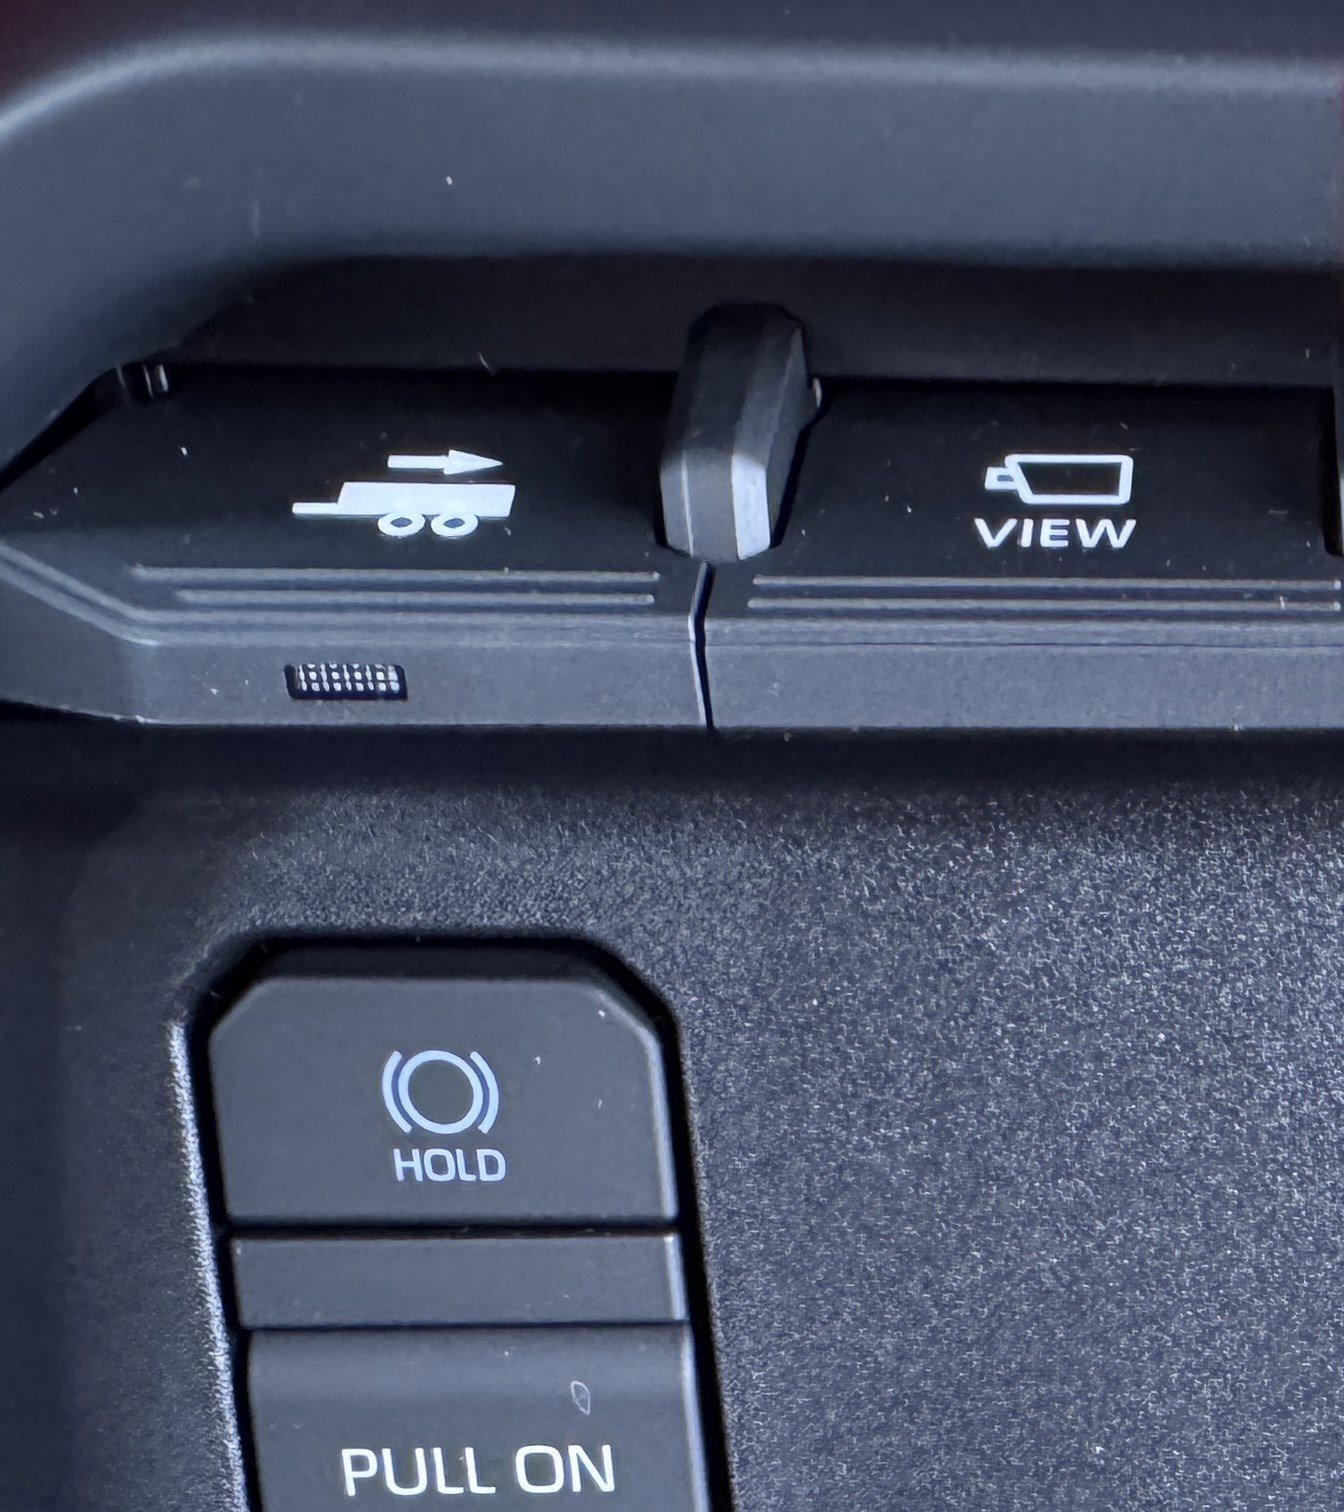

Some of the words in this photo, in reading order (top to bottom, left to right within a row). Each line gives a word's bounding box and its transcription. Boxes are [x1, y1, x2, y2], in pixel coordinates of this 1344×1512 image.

[973, 518, 1137, 550] VIEW
[393, 1148, 506, 1183] HOLD
[341, 1447, 496, 1497] PULL
[514, 1444, 615, 1493] ON
